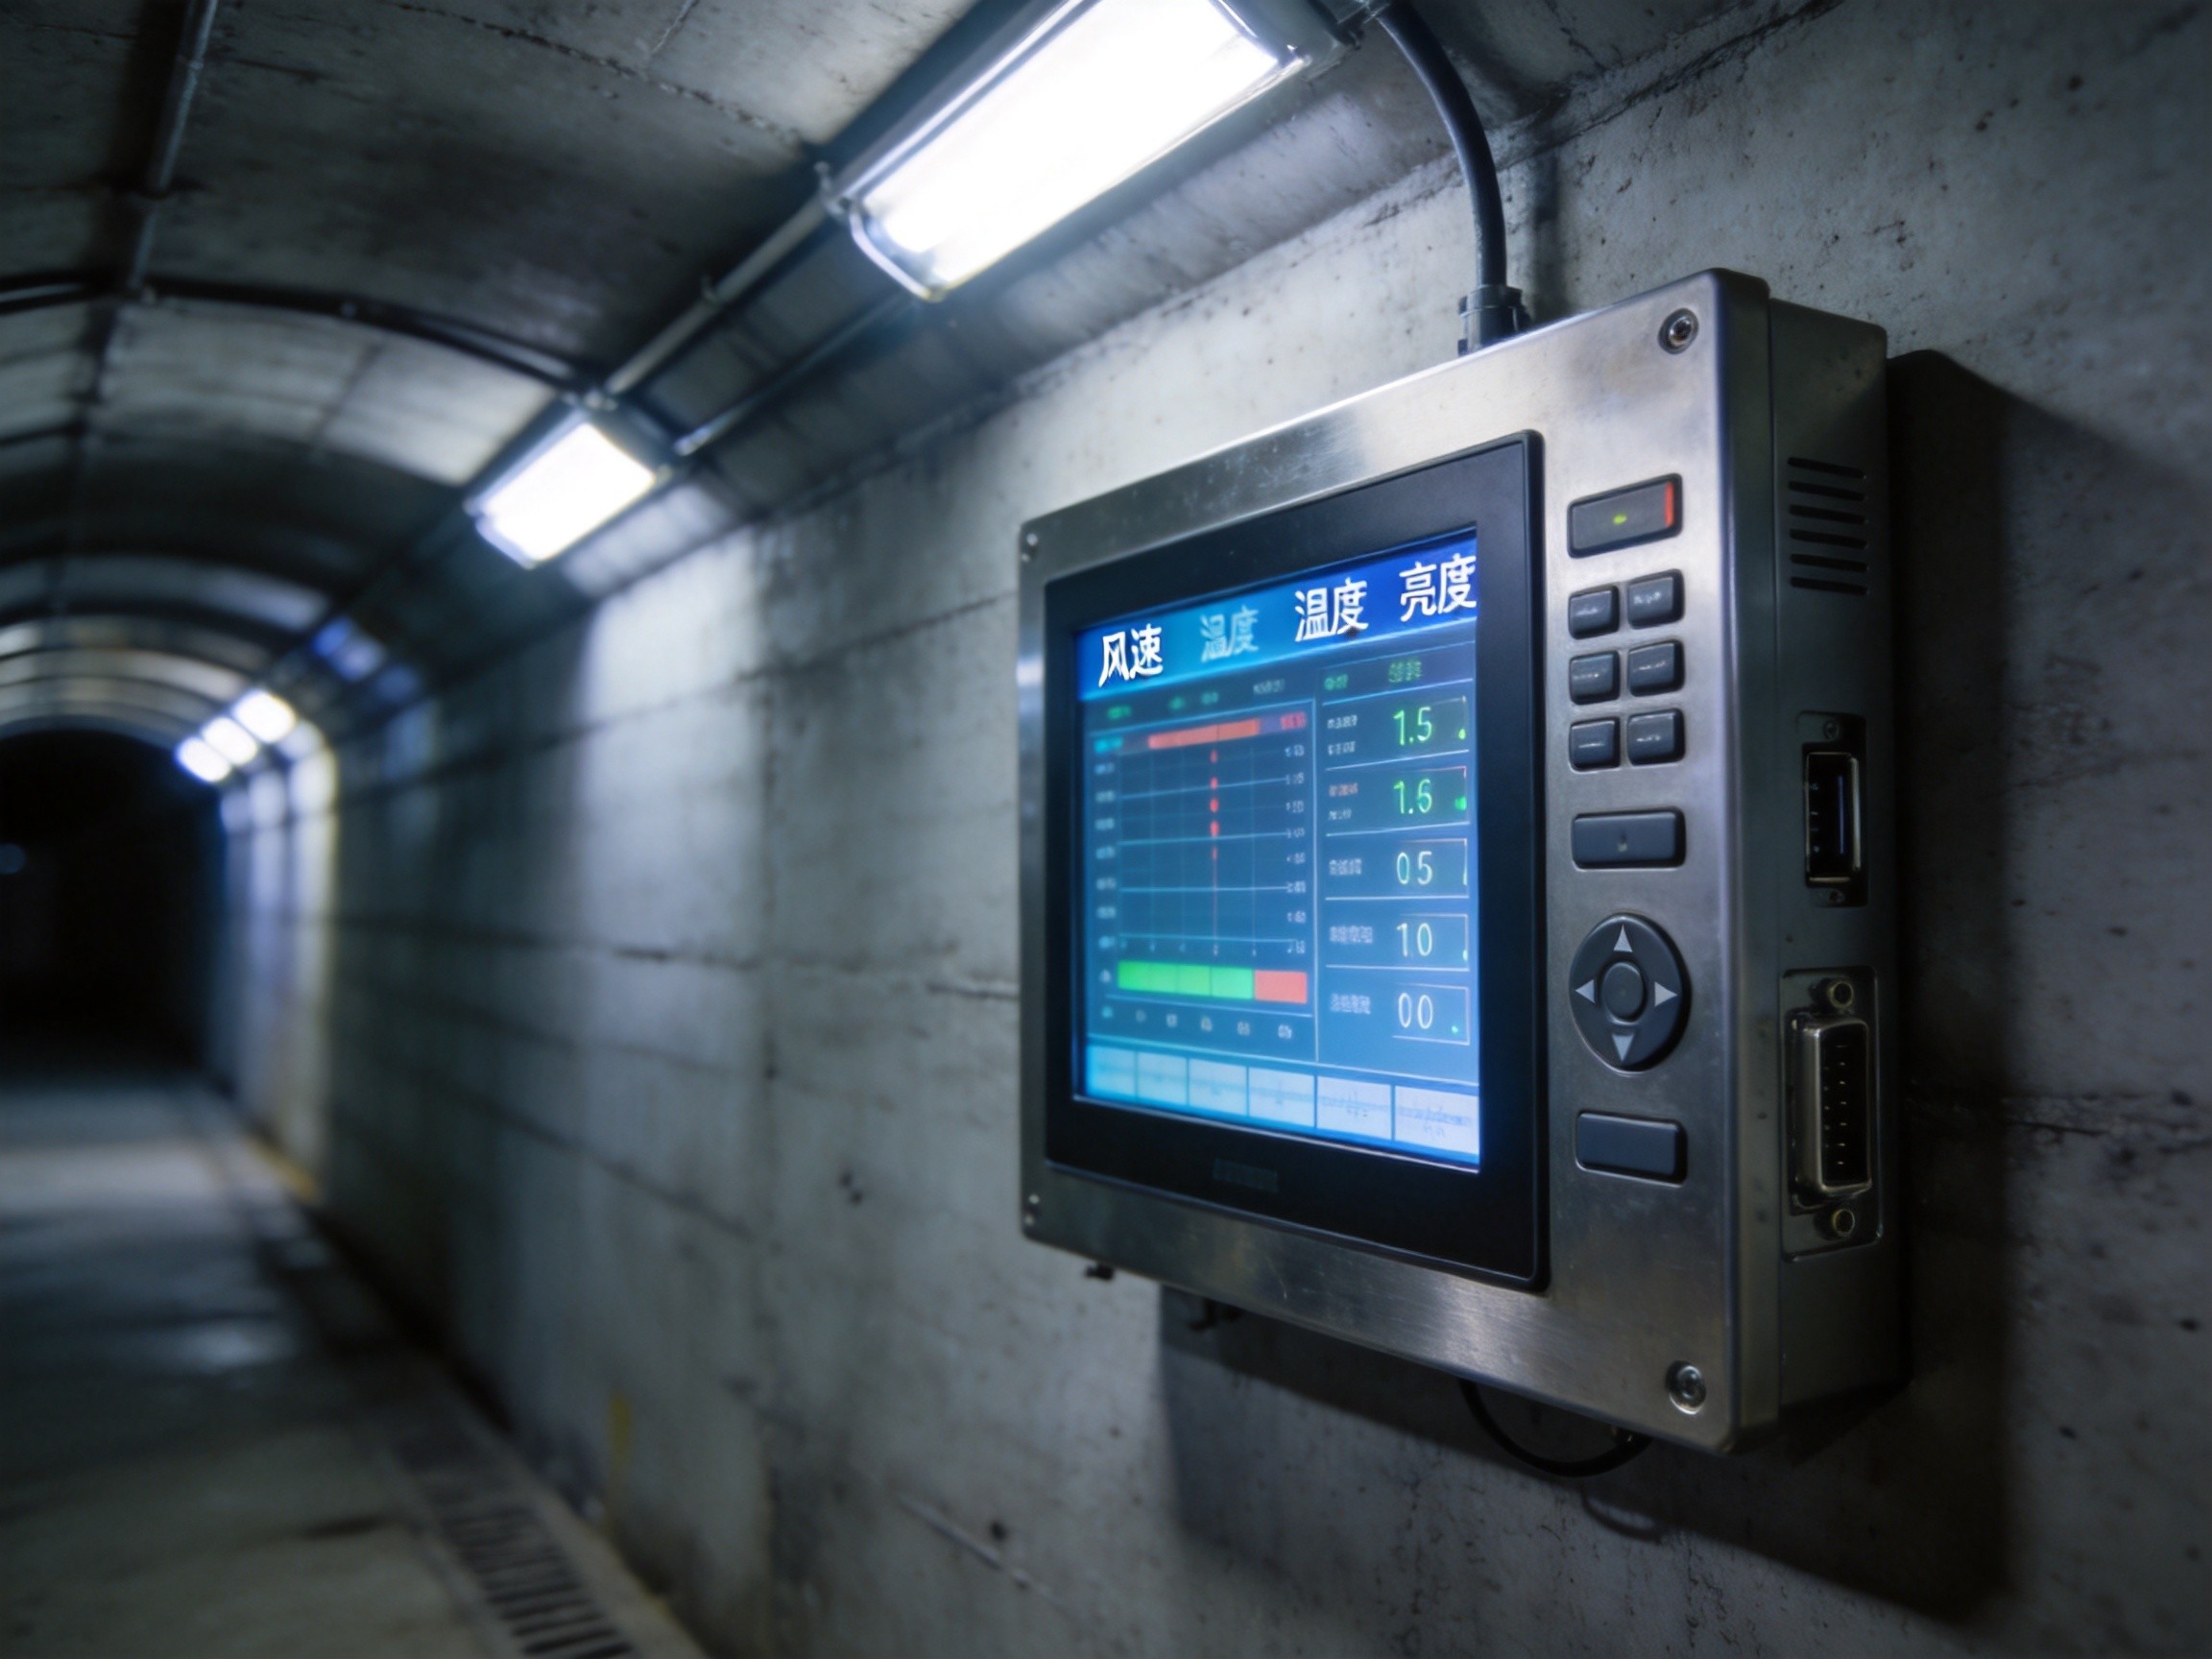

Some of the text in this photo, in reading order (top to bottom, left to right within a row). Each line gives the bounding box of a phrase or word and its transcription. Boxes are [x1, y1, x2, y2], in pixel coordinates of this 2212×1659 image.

[1098, 623, 1164, 687] 风速
[1294, 577, 1369, 641] 温度
[1399, 553, 1477, 622] 亮度
[1393, 706, 1432, 746] 1.5
[1394, 779, 1432, 814] 1.6
